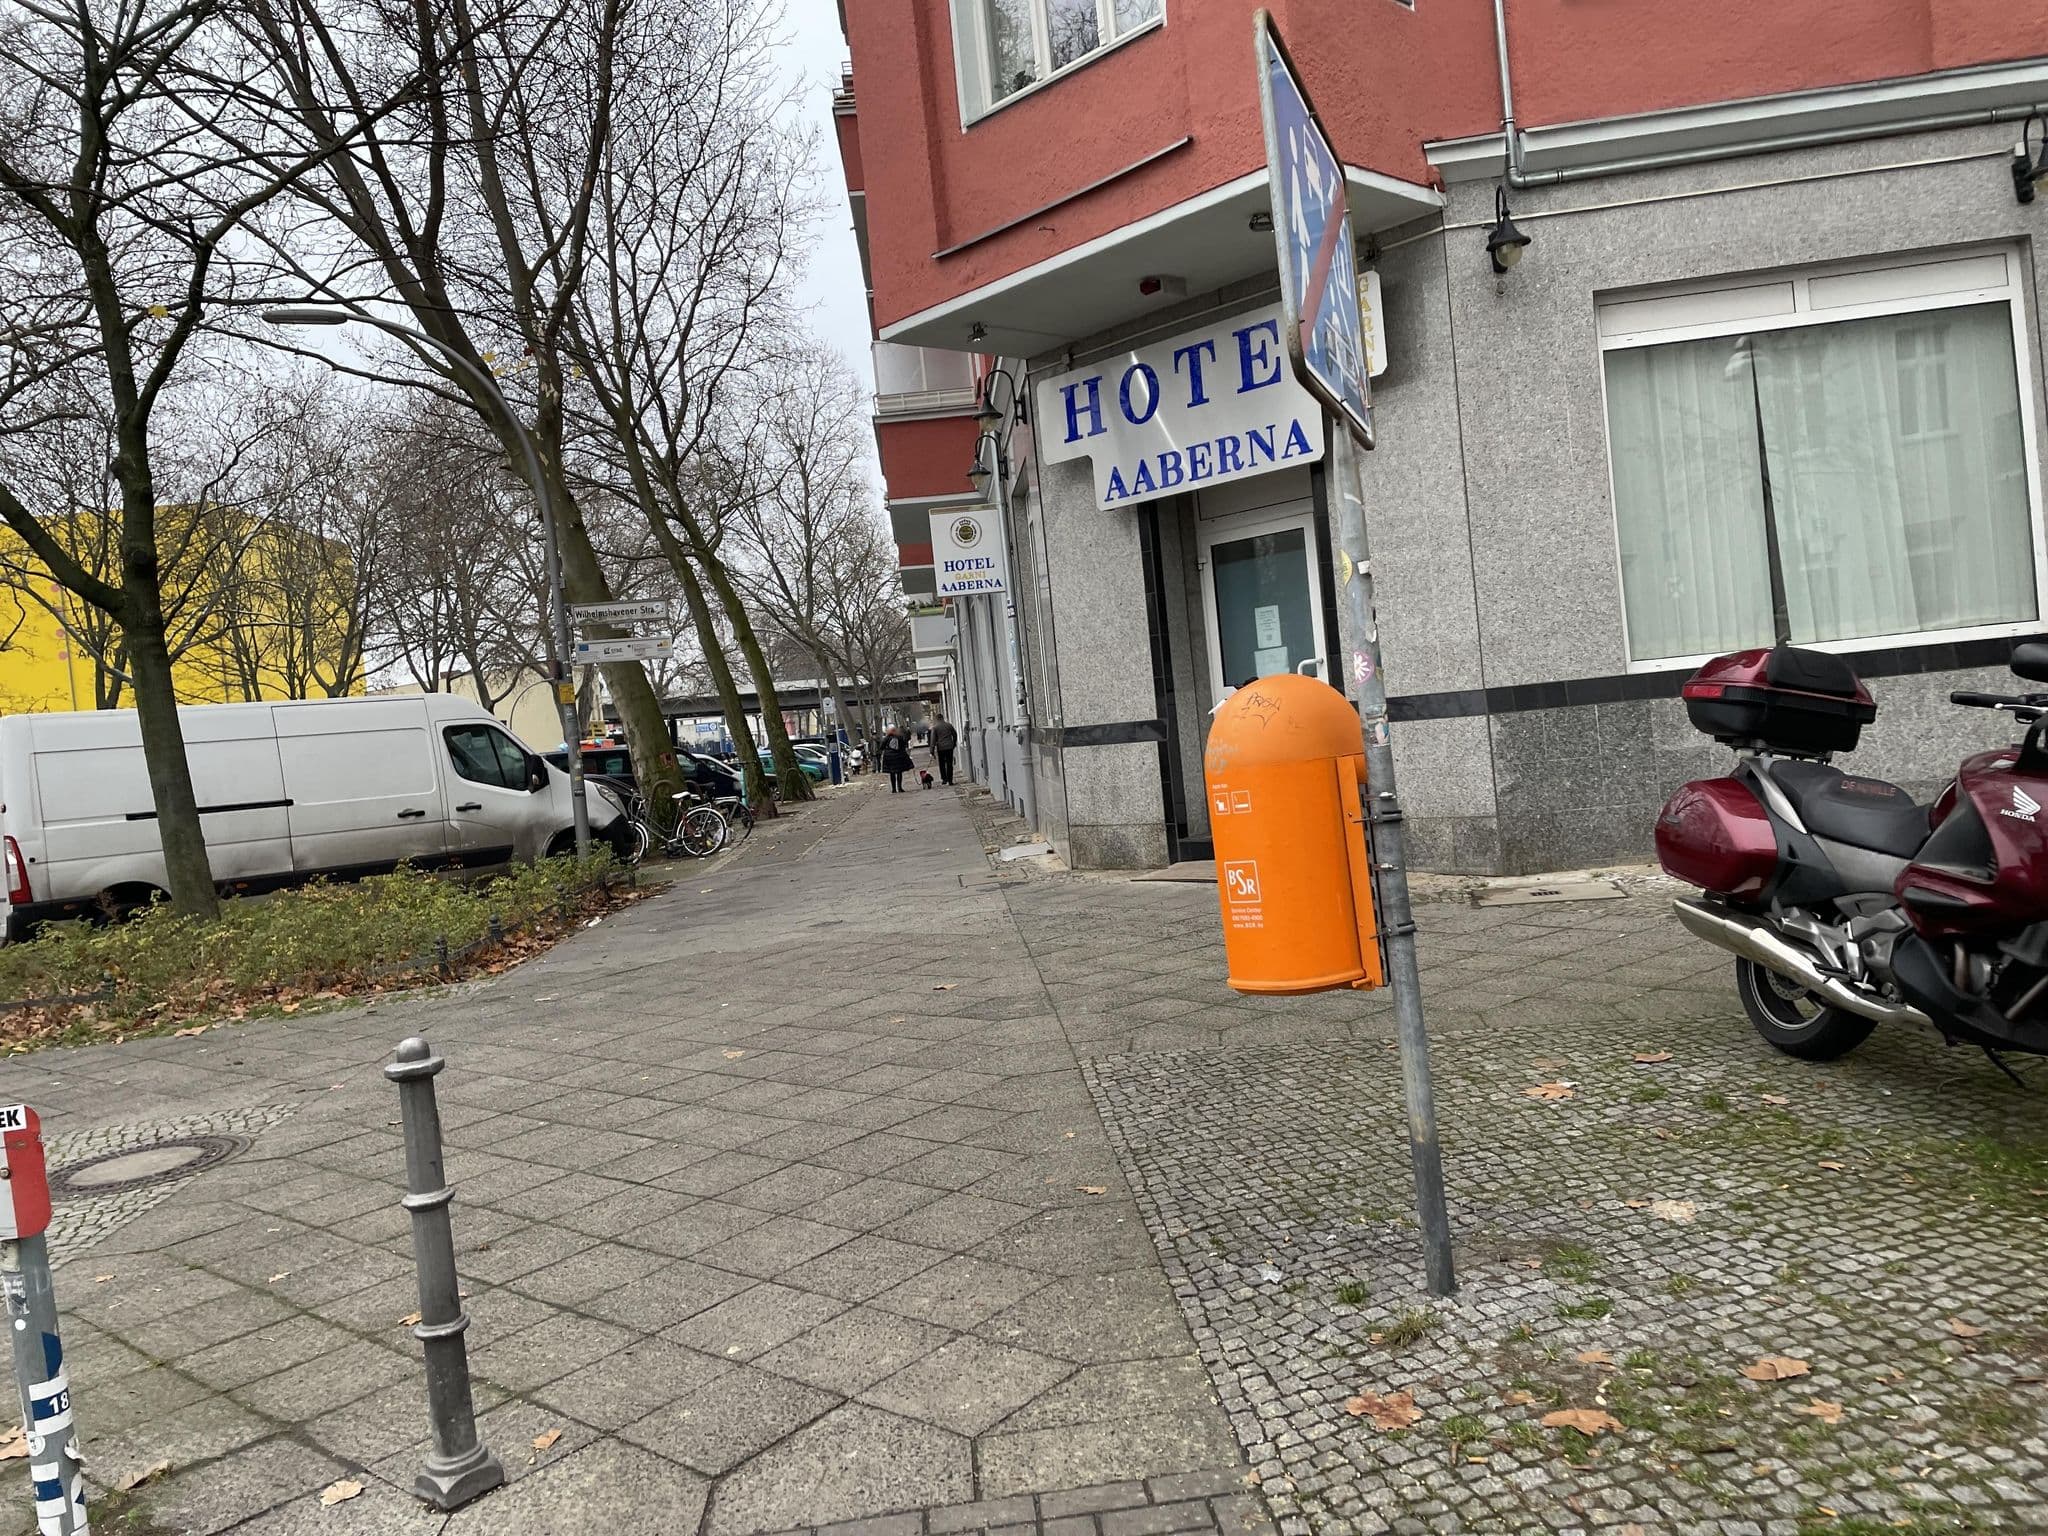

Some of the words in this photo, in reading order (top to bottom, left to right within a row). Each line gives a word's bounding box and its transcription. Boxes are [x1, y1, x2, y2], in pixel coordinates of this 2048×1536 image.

[1059, 319, 1282, 444] HOTE
[1104, 419, 1313, 502] AABERNA
[944, 557, 995, 573] HOTEL
[941, 578, 1003, 592] AABERNA
[574, 608, 637, 619] Wilhelmshavener
[640, 605, 664, 615] Stra
[2000, 809, 2036, 823] HONDA
[1228, 869, 1257, 895] BSR
[49, 1391, 70, 1414] 18
